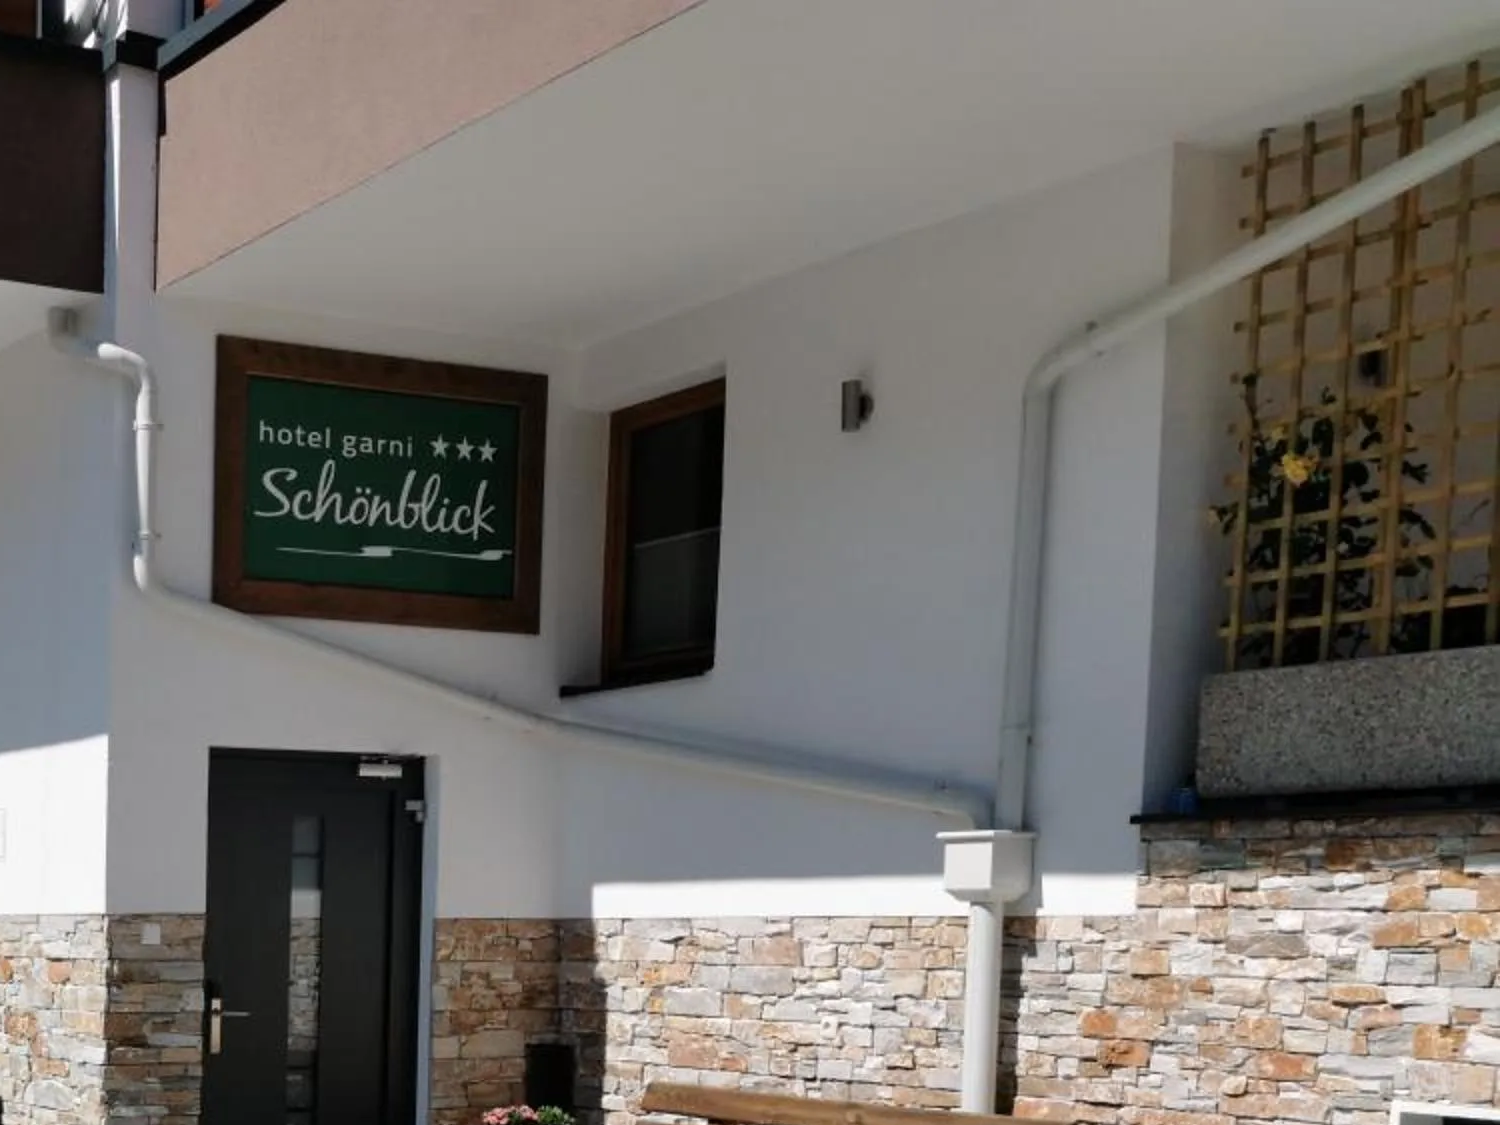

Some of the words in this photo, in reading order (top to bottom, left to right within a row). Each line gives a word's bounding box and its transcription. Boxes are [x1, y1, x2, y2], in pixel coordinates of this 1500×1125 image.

[258, 420, 332, 449] hotel
[342, 434, 414, 458] garni
[254, 459, 496, 541] Schönblick
